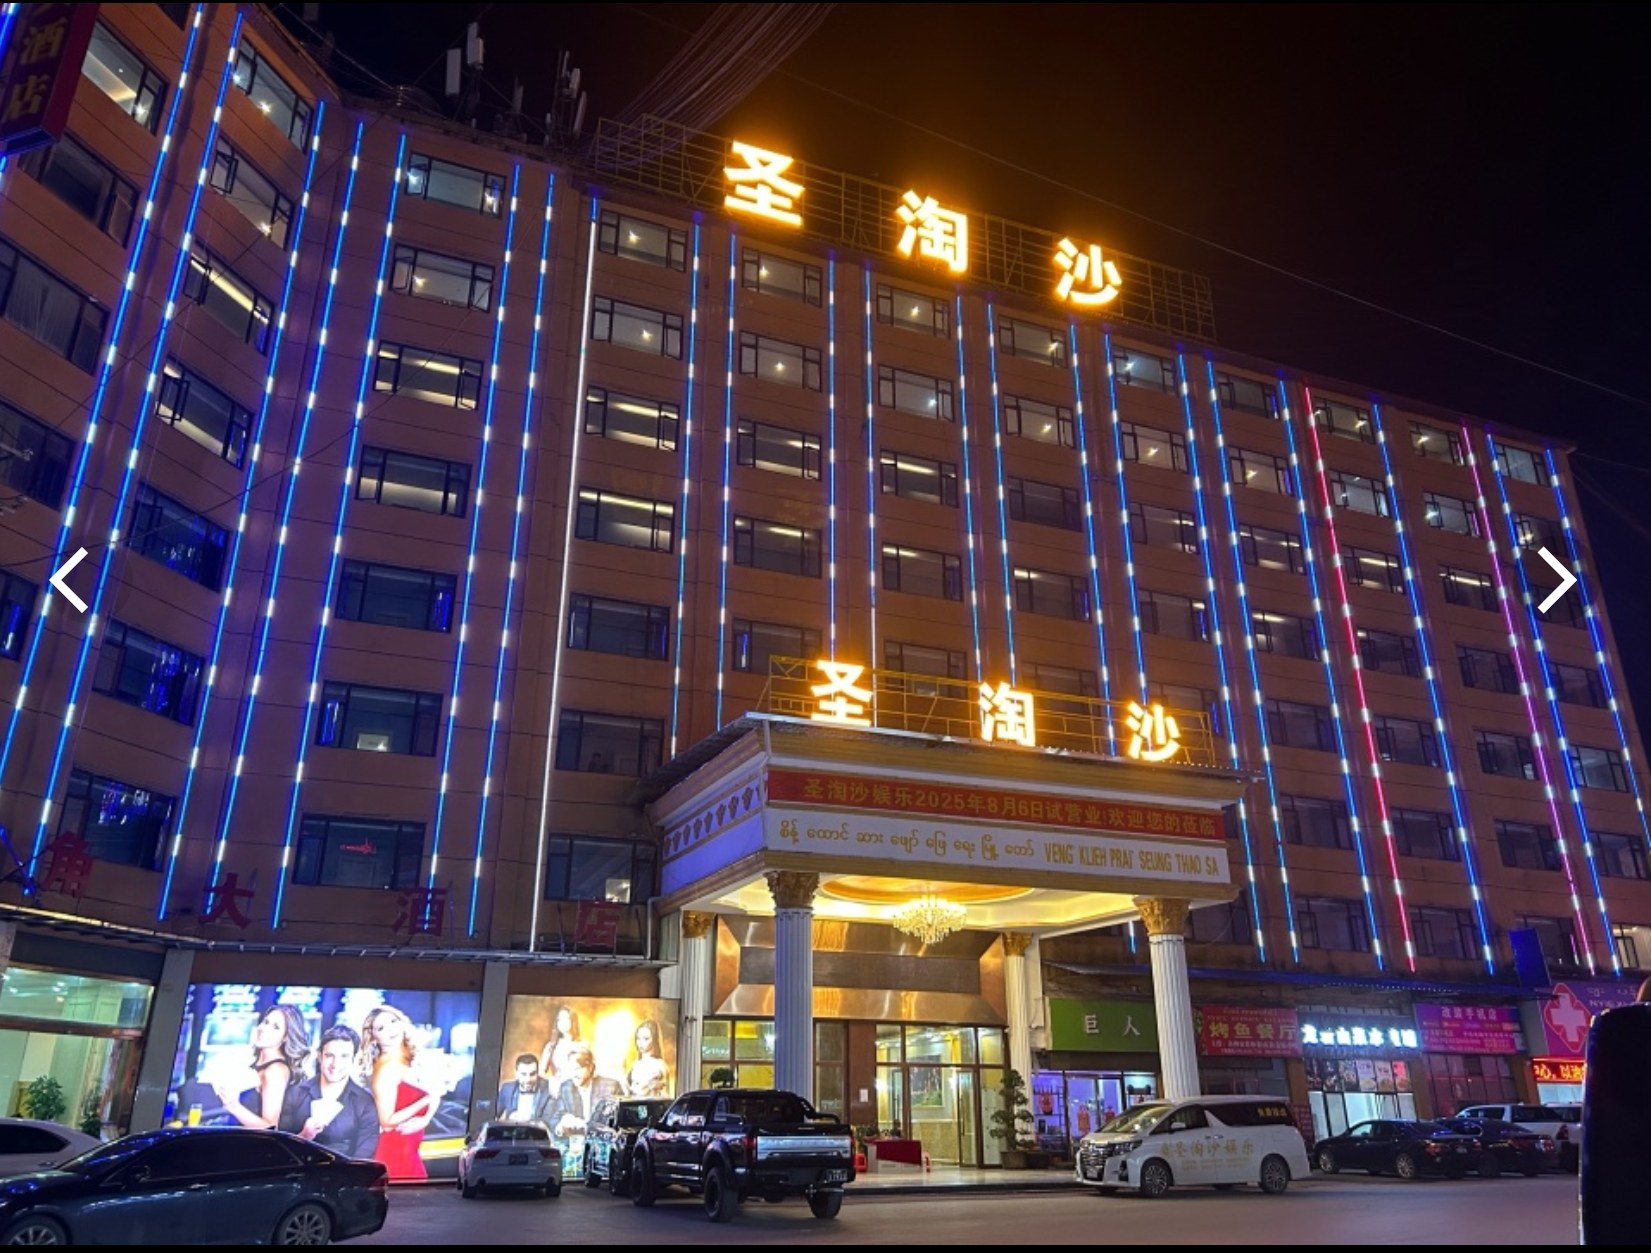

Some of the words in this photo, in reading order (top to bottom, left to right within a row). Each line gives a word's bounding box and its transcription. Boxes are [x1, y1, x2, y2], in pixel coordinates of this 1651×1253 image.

[2, 3, 68, 123] 酒店
[724, 140, 1122, 305] 圣淘沙
[810, 660, 1181, 760] 圣淘沙
[1044, 842, 1074, 865] VENG
[1138, 849, 1172, 872] SEUNG
[1175, 853, 1202, 874] THAO
[1205, 856, 1220, 876] SA
[1084, 1014, 1141, 1036] 巨人
[1209, 1022, 1296, 1040] 烤鱼餐厅
